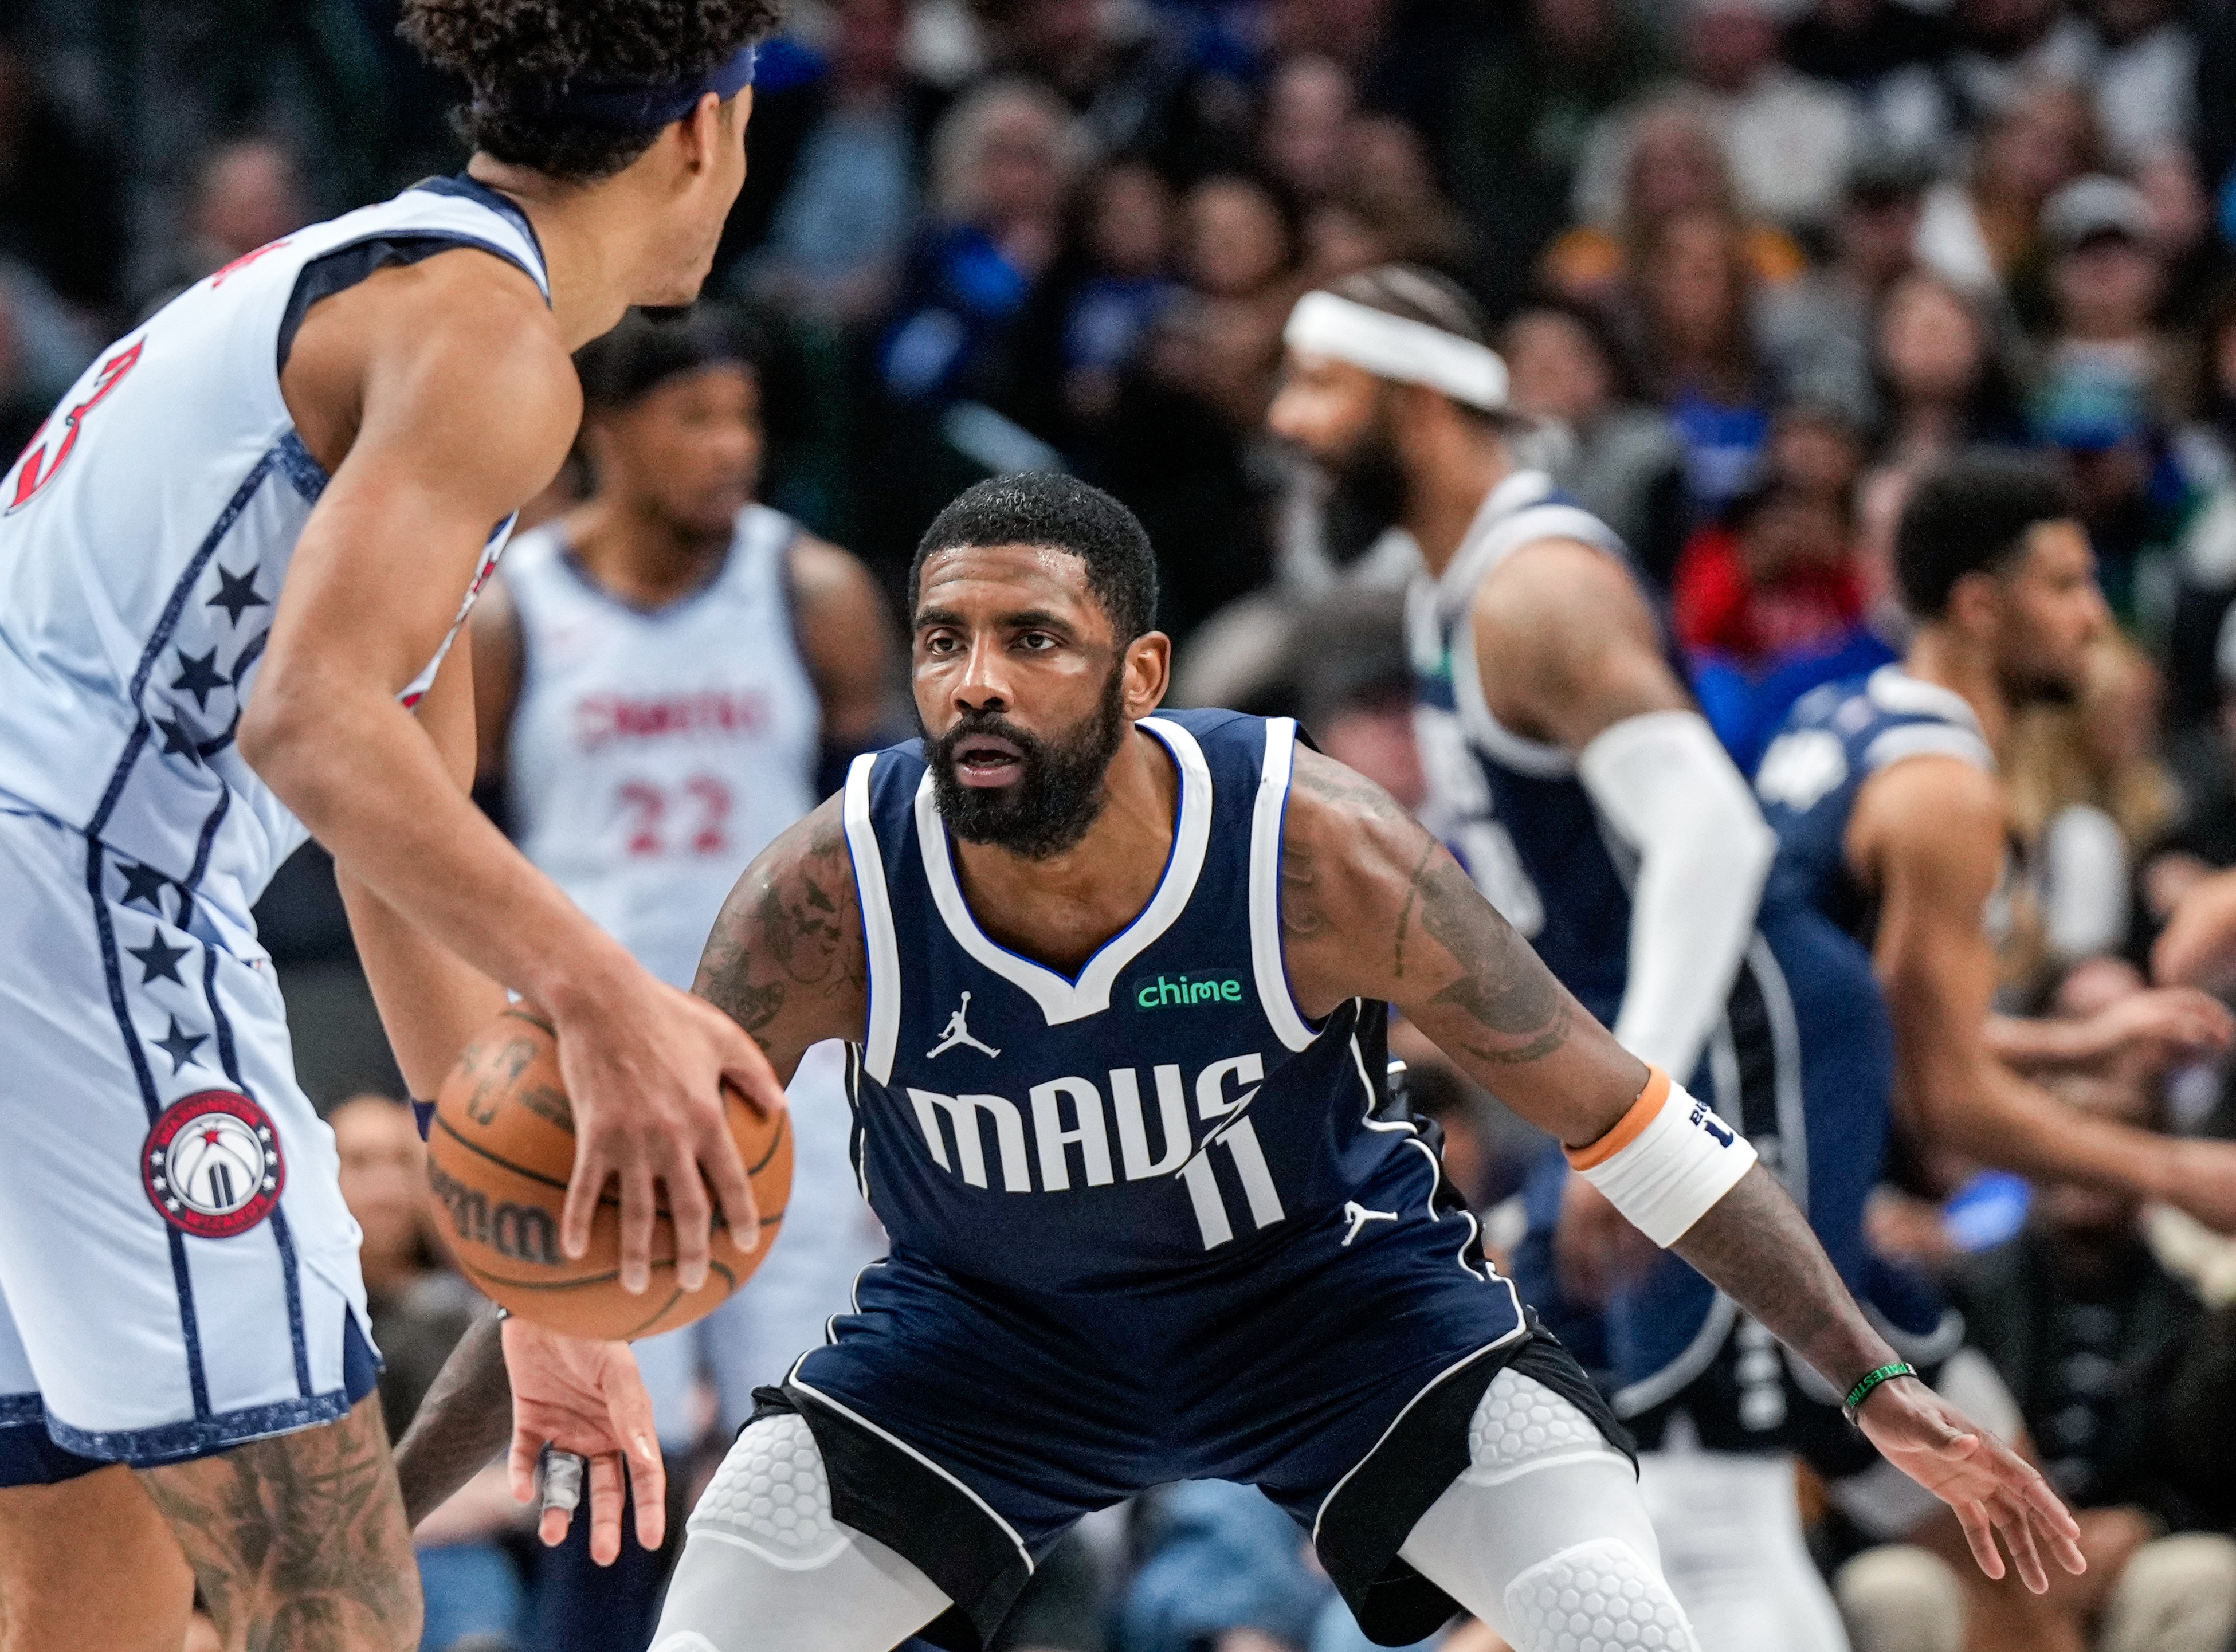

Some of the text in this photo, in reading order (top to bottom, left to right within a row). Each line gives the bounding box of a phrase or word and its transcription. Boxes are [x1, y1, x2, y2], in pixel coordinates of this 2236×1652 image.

[617, 774, 735, 857] 22
[1138, 975, 1242, 1008] chime
[906, 1053, 1264, 1192] MAVS
[1175, 1115, 1286, 1251] 11
